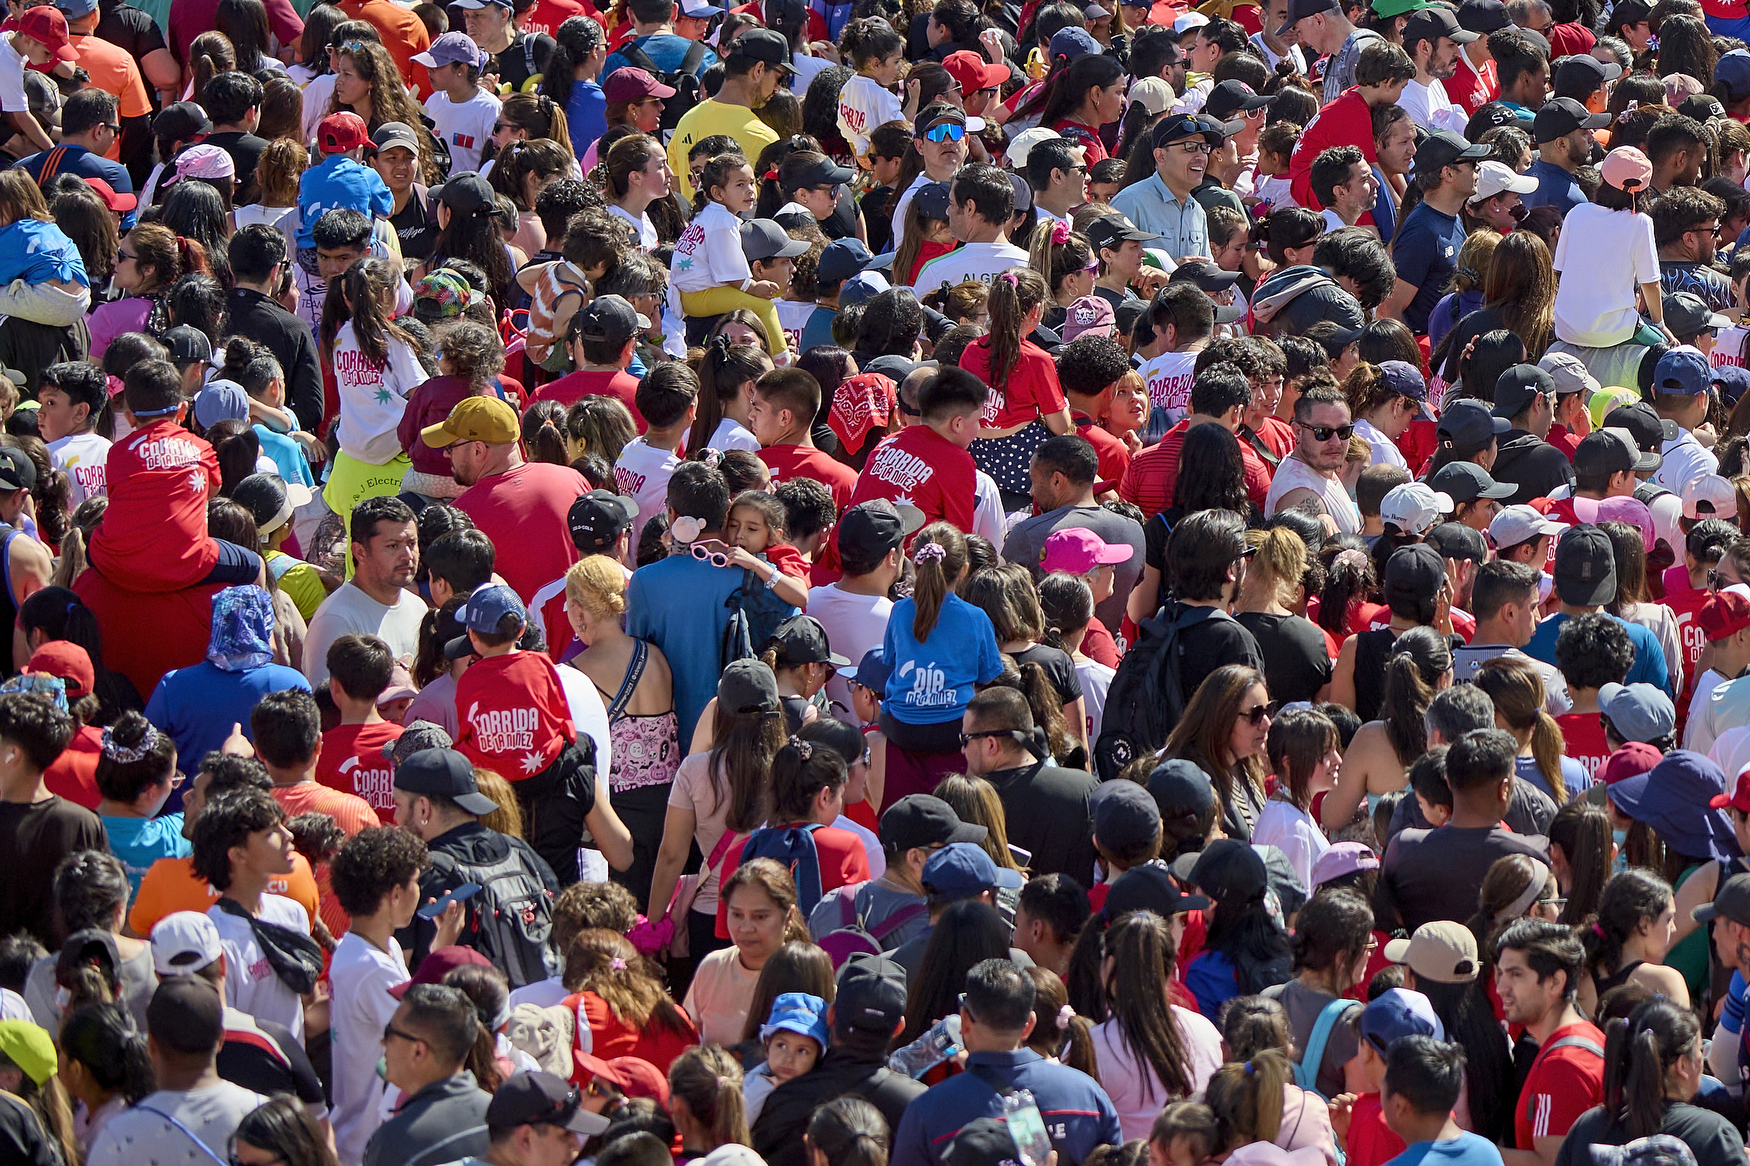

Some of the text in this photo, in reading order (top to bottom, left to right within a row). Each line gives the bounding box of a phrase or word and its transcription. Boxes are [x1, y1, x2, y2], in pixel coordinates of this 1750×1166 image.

[147, 455, 162, 470] DE
[870, 461, 883, 477] DE
[874, 445, 934, 484] CORRIDA
[915, 662, 945, 695] DÍA
[475, 708, 539, 734] CORRIDA
[479, 731, 534, 752] DE LA NIÑEZ
